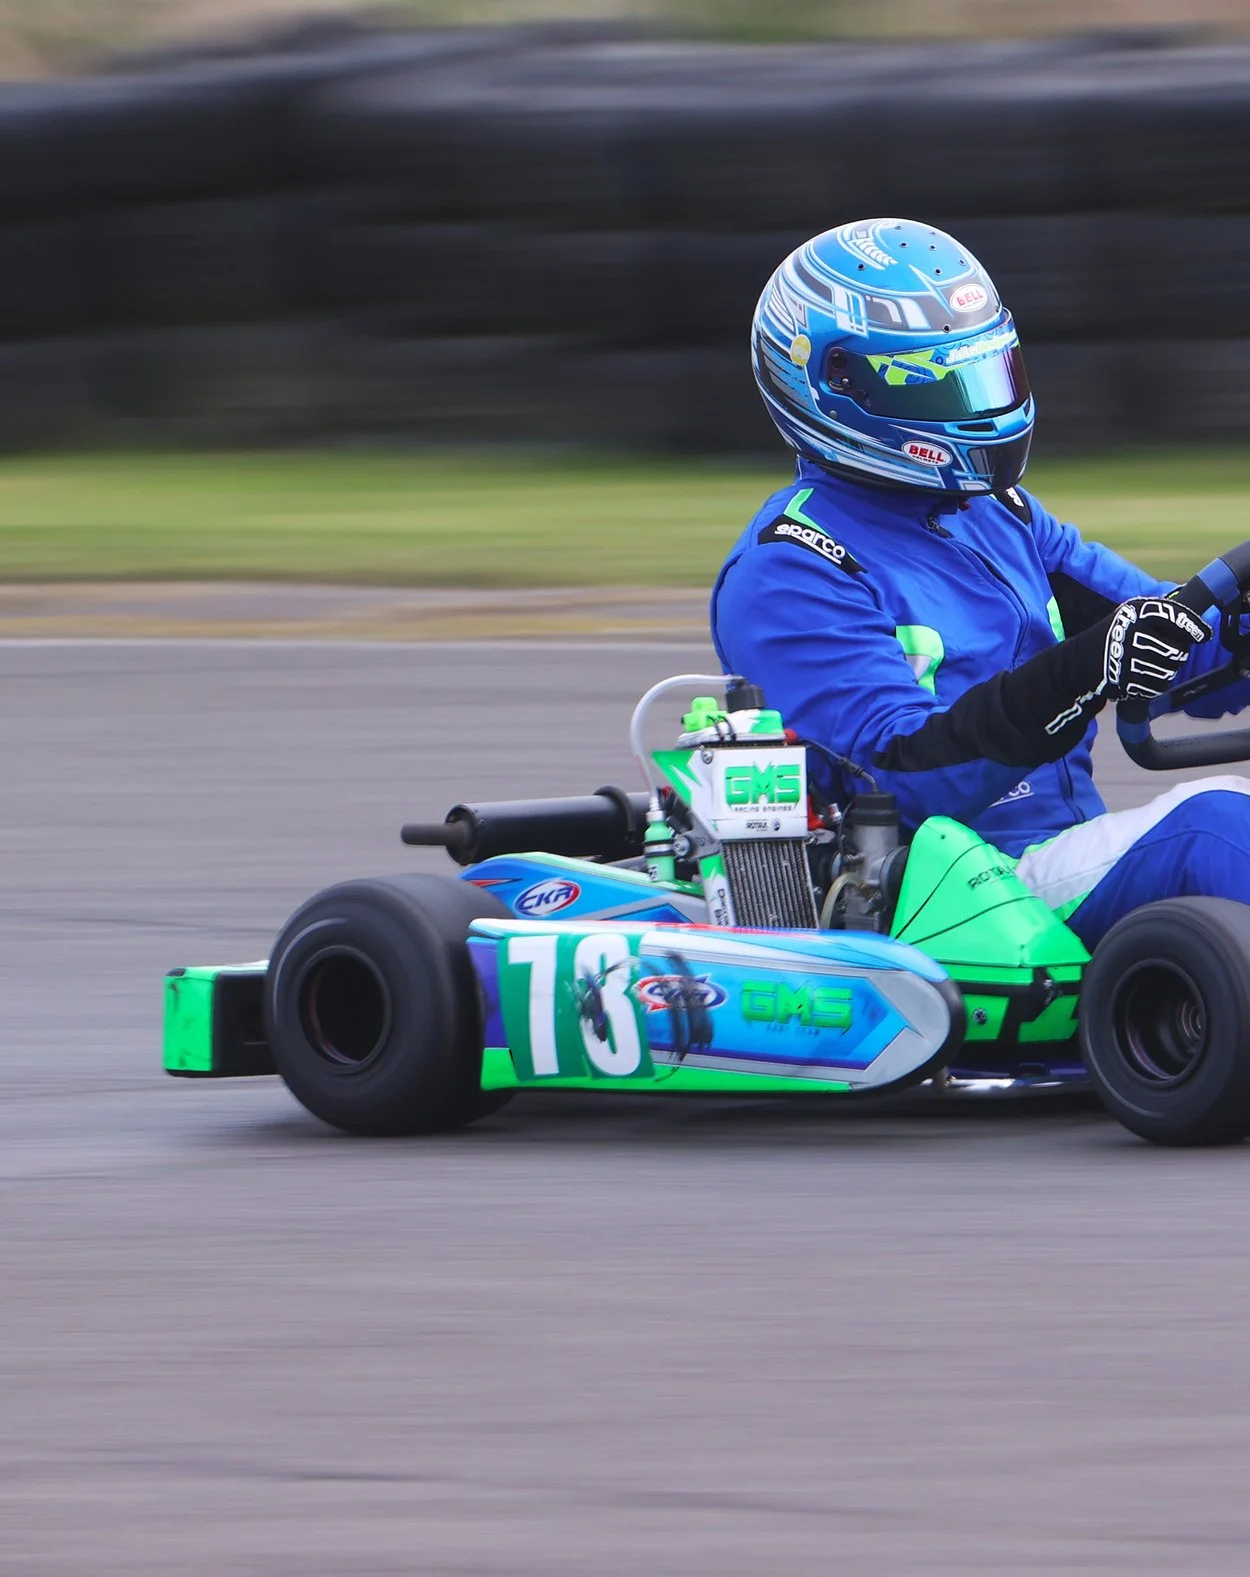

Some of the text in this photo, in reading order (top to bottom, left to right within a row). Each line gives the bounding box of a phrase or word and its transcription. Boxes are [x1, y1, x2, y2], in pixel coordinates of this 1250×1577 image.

[956, 289, 983, 306] BELL
[909, 444, 944, 462] BELL
[774, 523, 846, 559] sparco
[725, 761, 800, 804] GMS
[518, 886, 574, 910] CKR
[741, 981, 853, 1029] GMS
